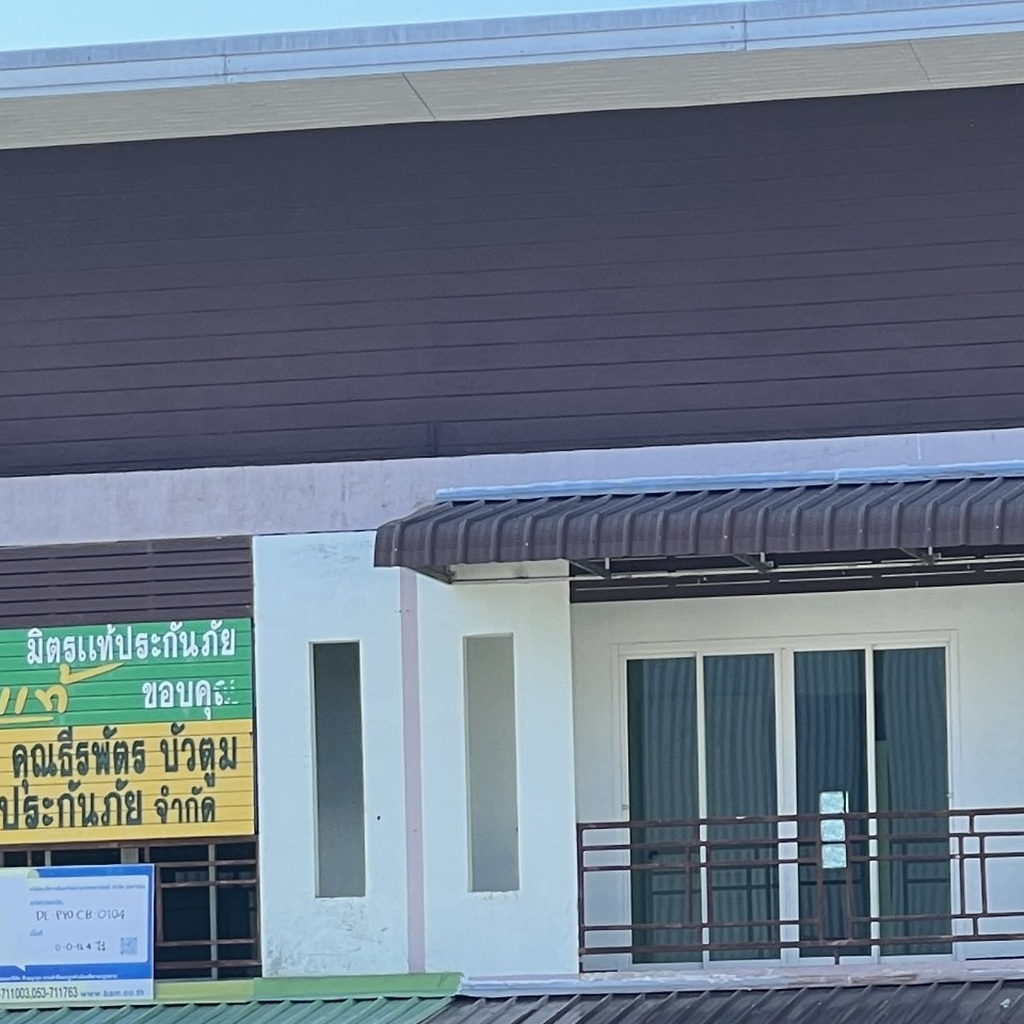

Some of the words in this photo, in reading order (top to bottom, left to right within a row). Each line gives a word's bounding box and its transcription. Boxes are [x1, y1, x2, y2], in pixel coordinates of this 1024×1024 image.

[27, 620, 236, 664] มิตรแท้ประกันภัย
[12, 726, 145, 794] คุณธีรพัตร
[160, 722, 237, 787] บัวตูม
[154, 785, 216, 824] จำกัด
